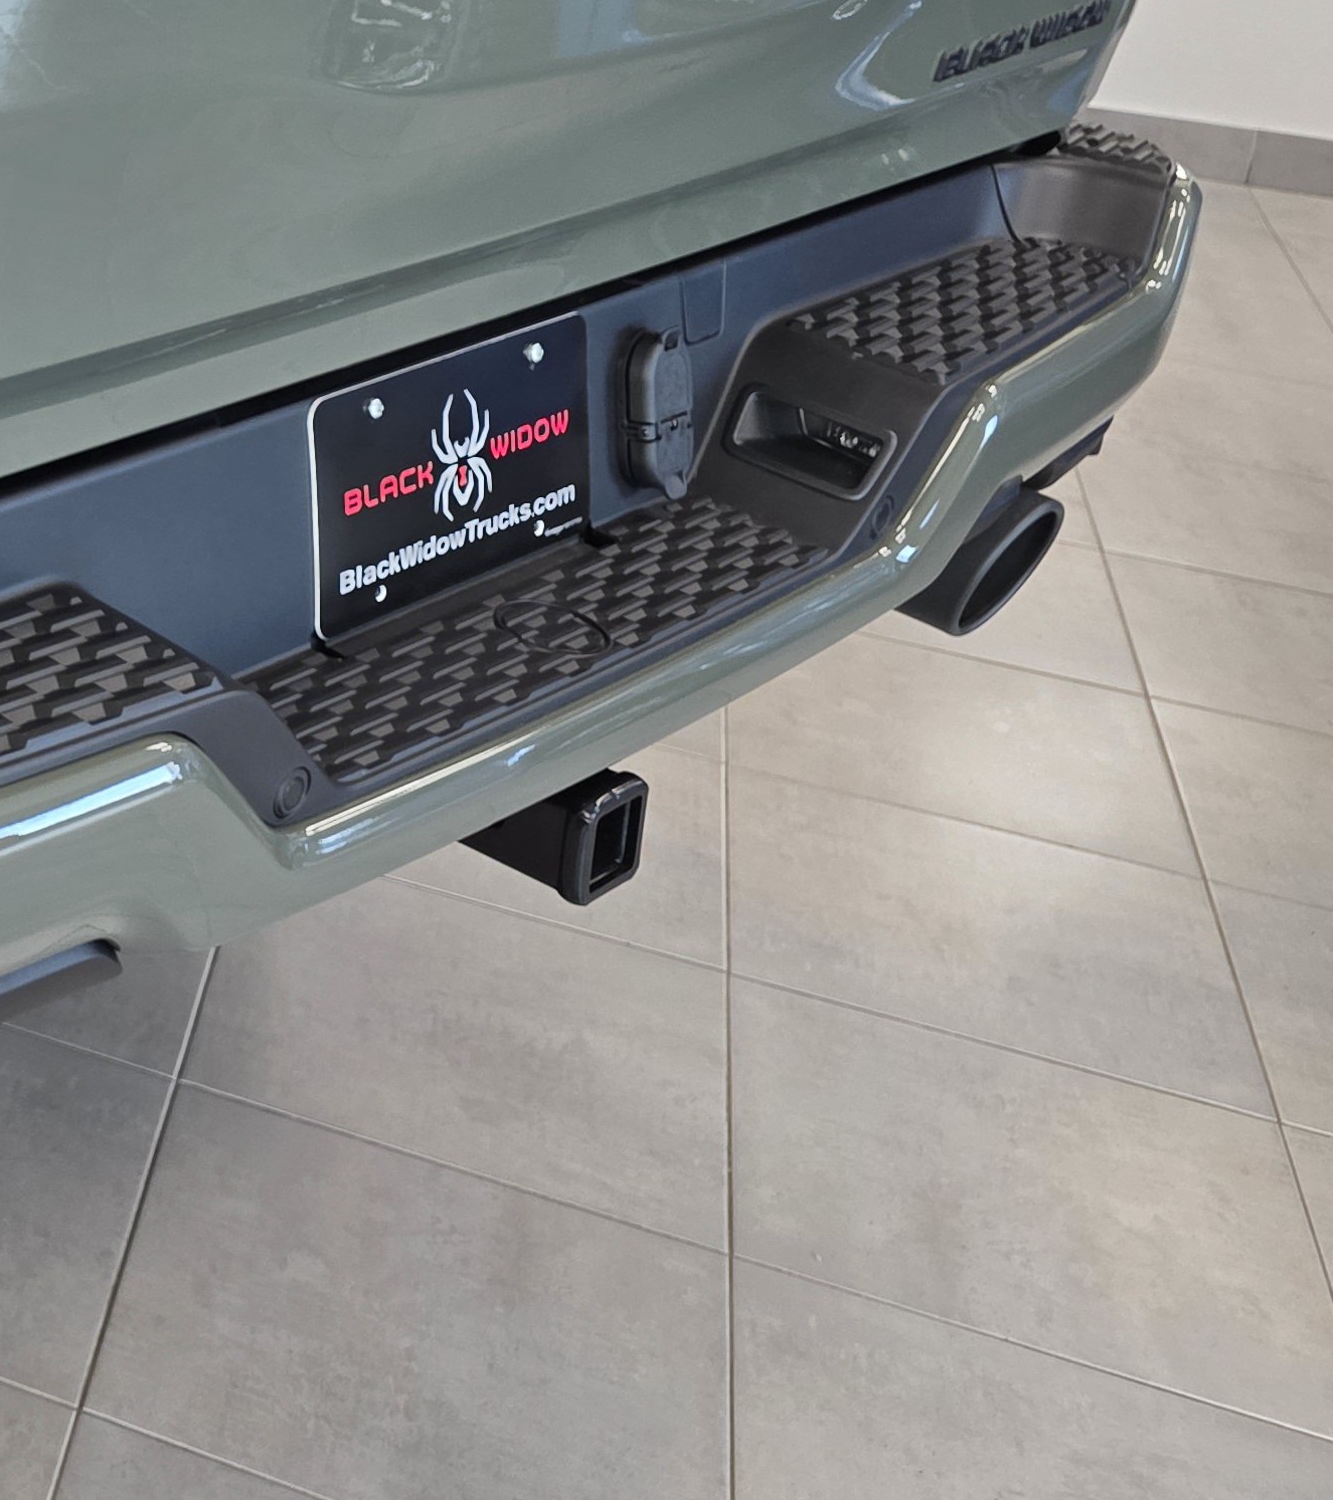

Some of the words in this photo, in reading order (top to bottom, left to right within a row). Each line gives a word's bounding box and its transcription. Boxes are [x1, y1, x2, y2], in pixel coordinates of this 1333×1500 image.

[933, 25, 1031, 83] BLACK
[344, 460, 434, 517] BLACK
[489, 409, 570, 460] WIDOW
[339, 483, 576, 596] BlackWidowTrucks.com
